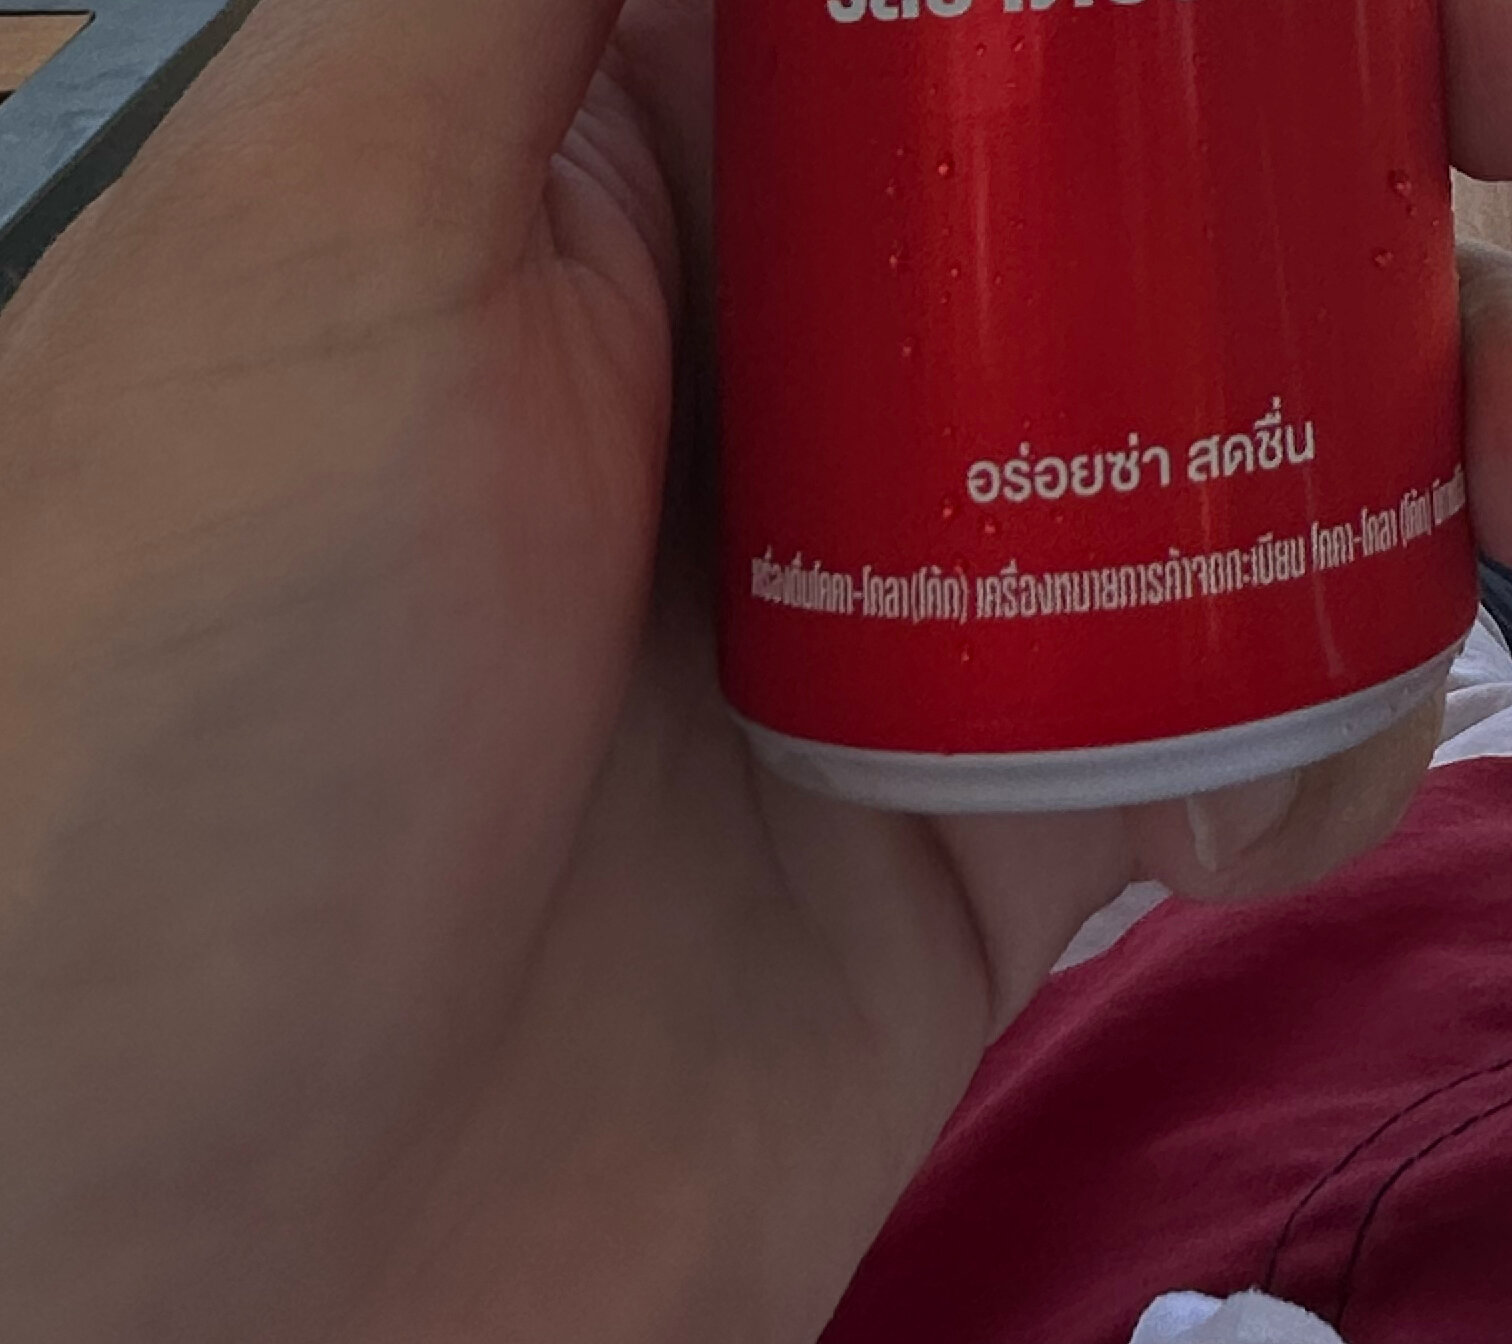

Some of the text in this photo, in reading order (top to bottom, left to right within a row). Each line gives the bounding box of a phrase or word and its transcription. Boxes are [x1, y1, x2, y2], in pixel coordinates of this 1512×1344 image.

[966, 396, 1316, 503] อร่อยซ่า สดชื่น
